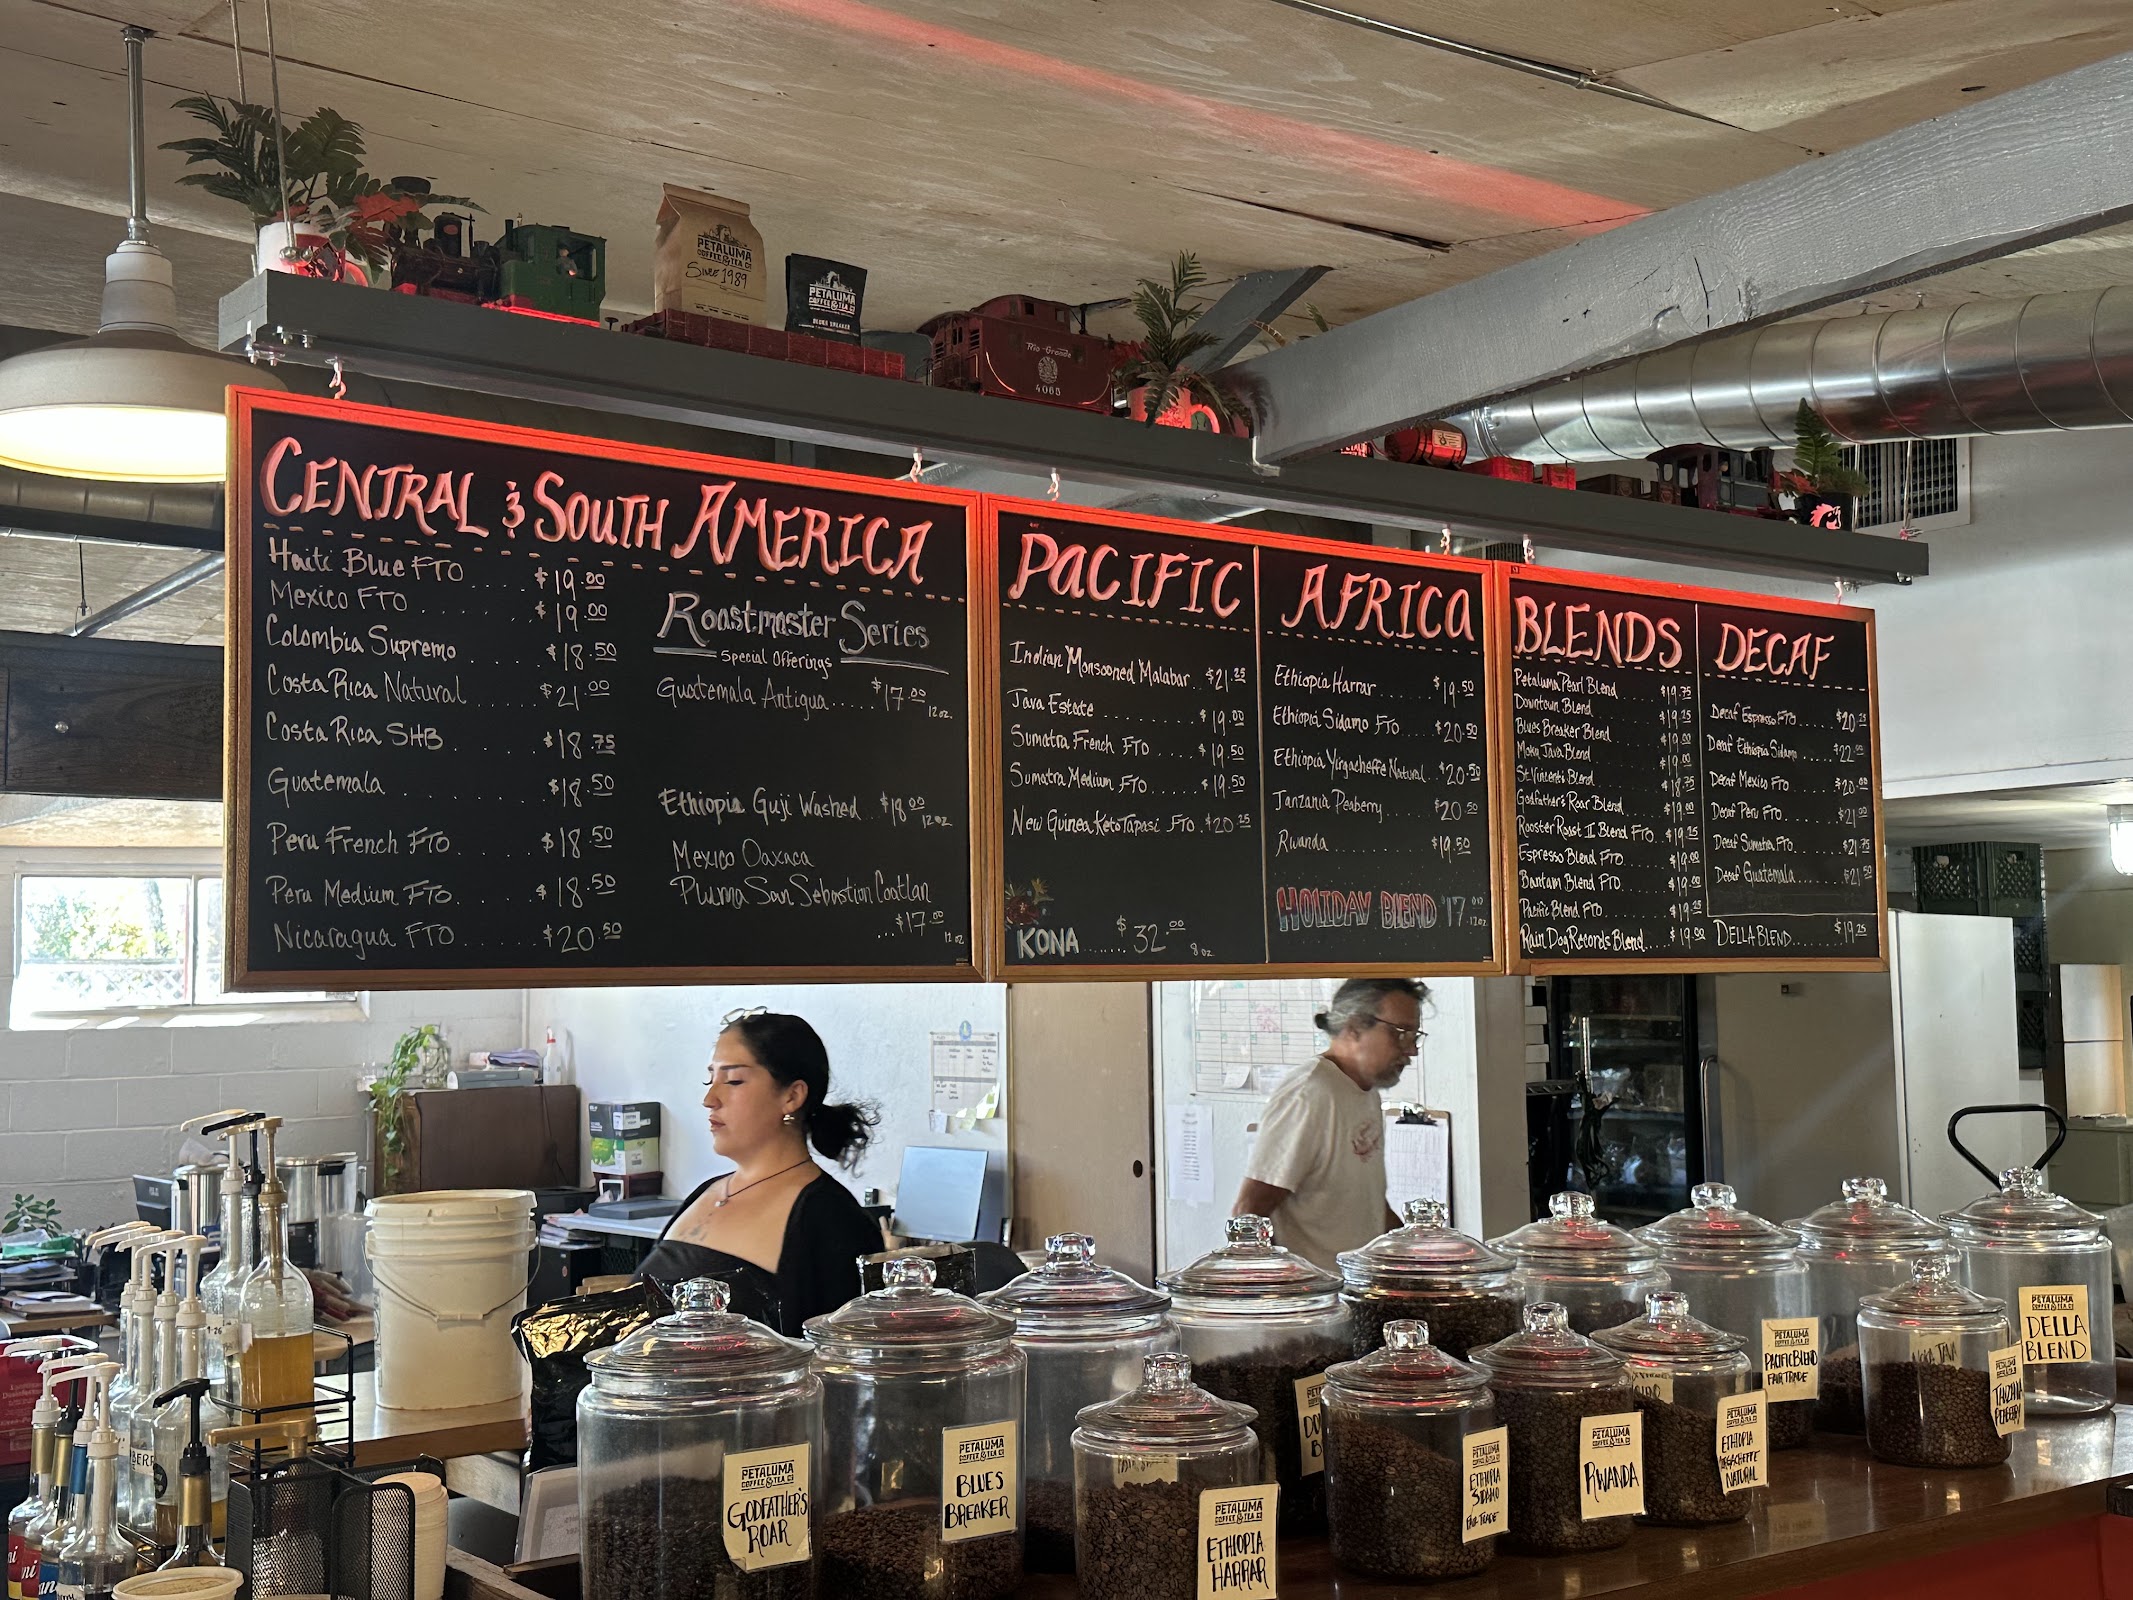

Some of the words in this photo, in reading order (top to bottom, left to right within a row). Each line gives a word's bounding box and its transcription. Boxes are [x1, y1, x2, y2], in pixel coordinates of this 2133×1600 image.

[697, 237, 752, 262] PETALUMA
[720, 268, 747, 289] 1989
[809, 286, 855, 305] PETALUMA
[260, 436, 490, 537] CENTRAL
[533, 470, 670, 551] SOUTH
[670, 480, 933, 585] AMERICA
[268, 537, 333, 572] Haiti
[342, 548, 406, 578] Blue
[411, 556, 464, 583] FTO
[271, 580, 349, 610] Mexico
[357, 585, 408, 612] FTO
[266, 613, 365, 655] Colombia
[368, 624, 457, 660] Supremo
[656, 590, 838, 648] Roastmaster
[838, 600, 931, 656] Series
[1513, 595, 1683, 670] BLENDS
[772, 650, 833, 680] Offerings
[1009, 641, 1064, 669] Indian
[1064, 645, 1136, 686] Monsooned
[1138, 658, 1191, 689] Malabar
[1713, 623, 1835, 681] DECAF
[267, 663, 329, 696] Costa
[328, 667, 379, 701] Rica
[384, 670, 467, 705] Natural
[1274, 663, 1331, 695] Ethiopia
[1332, 665, 1378, 697] Harrar
[1513, 667, 1561, 693] Petaluma
[1556, 671, 1585, 695] Pearl
[1585, 676, 1619, 700] Blend
[656, 674, 757, 709] Guatemala
[761, 677, 830, 722] Antigua
[1007, 688, 1046, 711] Java
[1048, 693, 1095, 717] Estate
[1513, 692, 1560, 714] Downtown
[1561, 697, 1594, 718] Blend
[1710, 702, 1741, 721] Decaf
[1777, 710, 1798, 726] FTO
[266, 711, 329, 744] Costa
[329, 715, 383, 747] Rica
[386, 722, 445, 751] SHB
[1272, 705, 1323, 728] Ethiopia
[1322, 708, 1370, 734] Sidamo
[1374, 714, 1401, 736] FTO
[1514, 716, 1541, 736] Blues
[1541, 718, 1581, 739] Breaker
[1581, 722, 1613, 743] Blend
[1011, 723, 1071, 750] Sumatra
[1072, 729, 1115, 755] French
[1121, 736, 1150, 756] FTO
[1540, 742, 1564, 760] Java
[1563, 742, 1592, 763] Blend
[1009, 761, 1067, 788] Sumatra
[1067, 766, 1115, 791] Medium
[1119, 774, 1148, 794] FTO
[1273, 747, 1327, 770] Ethiopia
[1388, 757, 1427, 784] Natural
[1567, 768, 1596, 788] Blend
[1709, 770, 1737, 788] Decaf
[1738, 769, 1769, 790] Mexico
[1770, 776, 1790, 792] FTO
[267, 767, 386, 808] Guatemala
[1272, 789, 1331, 811] Tanzania
[1566, 790, 1590, 813] Roar
[1590, 794, 1625, 816] Blend
[658, 787, 746, 826] Ethiopia
[752, 786, 792, 827] Guji
[799, 790, 862, 822] Washed
[1710, 801, 1737, 821] Decaf
[1736, 801, 1760, 819] Peru
[1762, 804, 1783, 821] FTO
[1011, 805, 1043, 837] New
[1046, 808, 1095, 841] Guinea
[1166, 813, 1196, 834] FTO
[1516, 815, 1556, 839] Rooster
[1597, 821, 1629, 840] Blend
[1630, 823, 1656, 843] FTO
[266, 822, 320, 857] Peru
[325, 824, 400, 858] French
[407, 826, 452, 855] FTO
[672, 840, 736, 872] Mexico
[742, 838, 815, 868] Oaxaca
[1275, 828, 1330, 858] Rwanda
[1518, 842, 1565, 864] Espresso
[1564, 847, 1598, 866] Blend
[1599, 848, 1624, 867] FTO
[1775, 836, 1794, 852] FTO
[265, 875, 313, 906] Peru
[324, 878, 400, 908] Medium
[402, 879, 453, 906] FTO
[669, 875, 749, 910] Pluma
[744, 876, 794, 906] San
[1518, 869, 1563, 891] Bantam
[1563, 872, 1596, 893] Blend
[1597, 873, 1622, 892] FTO
[1276, 886, 1372, 933] HOLIDAY
[1380, 890, 1438, 930] BLEND
[1518, 897, 1551, 920] Pacific
[1550, 899, 1581, 921] Blend
[1582, 901, 1603, 919] FTO
[273, 923, 397, 961] Nicaragua
[404, 921, 456, 949] FTO
[1017, 926, 1080, 960] KONA
[1519, 923, 1547, 954] Rain
[1546, 926, 1570, 955] Dog
[1611, 928, 1646, 953] Blend
[2031, 1294, 2074, 1304] PETALUMA
[2026, 1314, 2088, 1339] DELLA
[2025, 1340, 2087, 1362] BLEND
[959, 1438, 1005, 1454] PETALUMA
[1592, 1426, 1631, 1439] PETALUMA
[741, 1478, 765, 1489] COFFEE
[766, 1477, 774, 1489] &
[774, 1474, 785, 1484] TEA
[742, 1462, 794, 1480] PETALUMA
[956, 1471, 1004, 1498] BLUES
[1583, 1461, 1640, 1503] RWANDA
[944, 1495, 1011, 1529] BREAKER
[1215, 1500, 1264, 1516] PETALUMA
[747, 1518, 793, 1558] ROAR
[1206, 1531, 1265, 1563] ETHIOPIA
[1212, 1556, 1270, 1593] HARRAR
